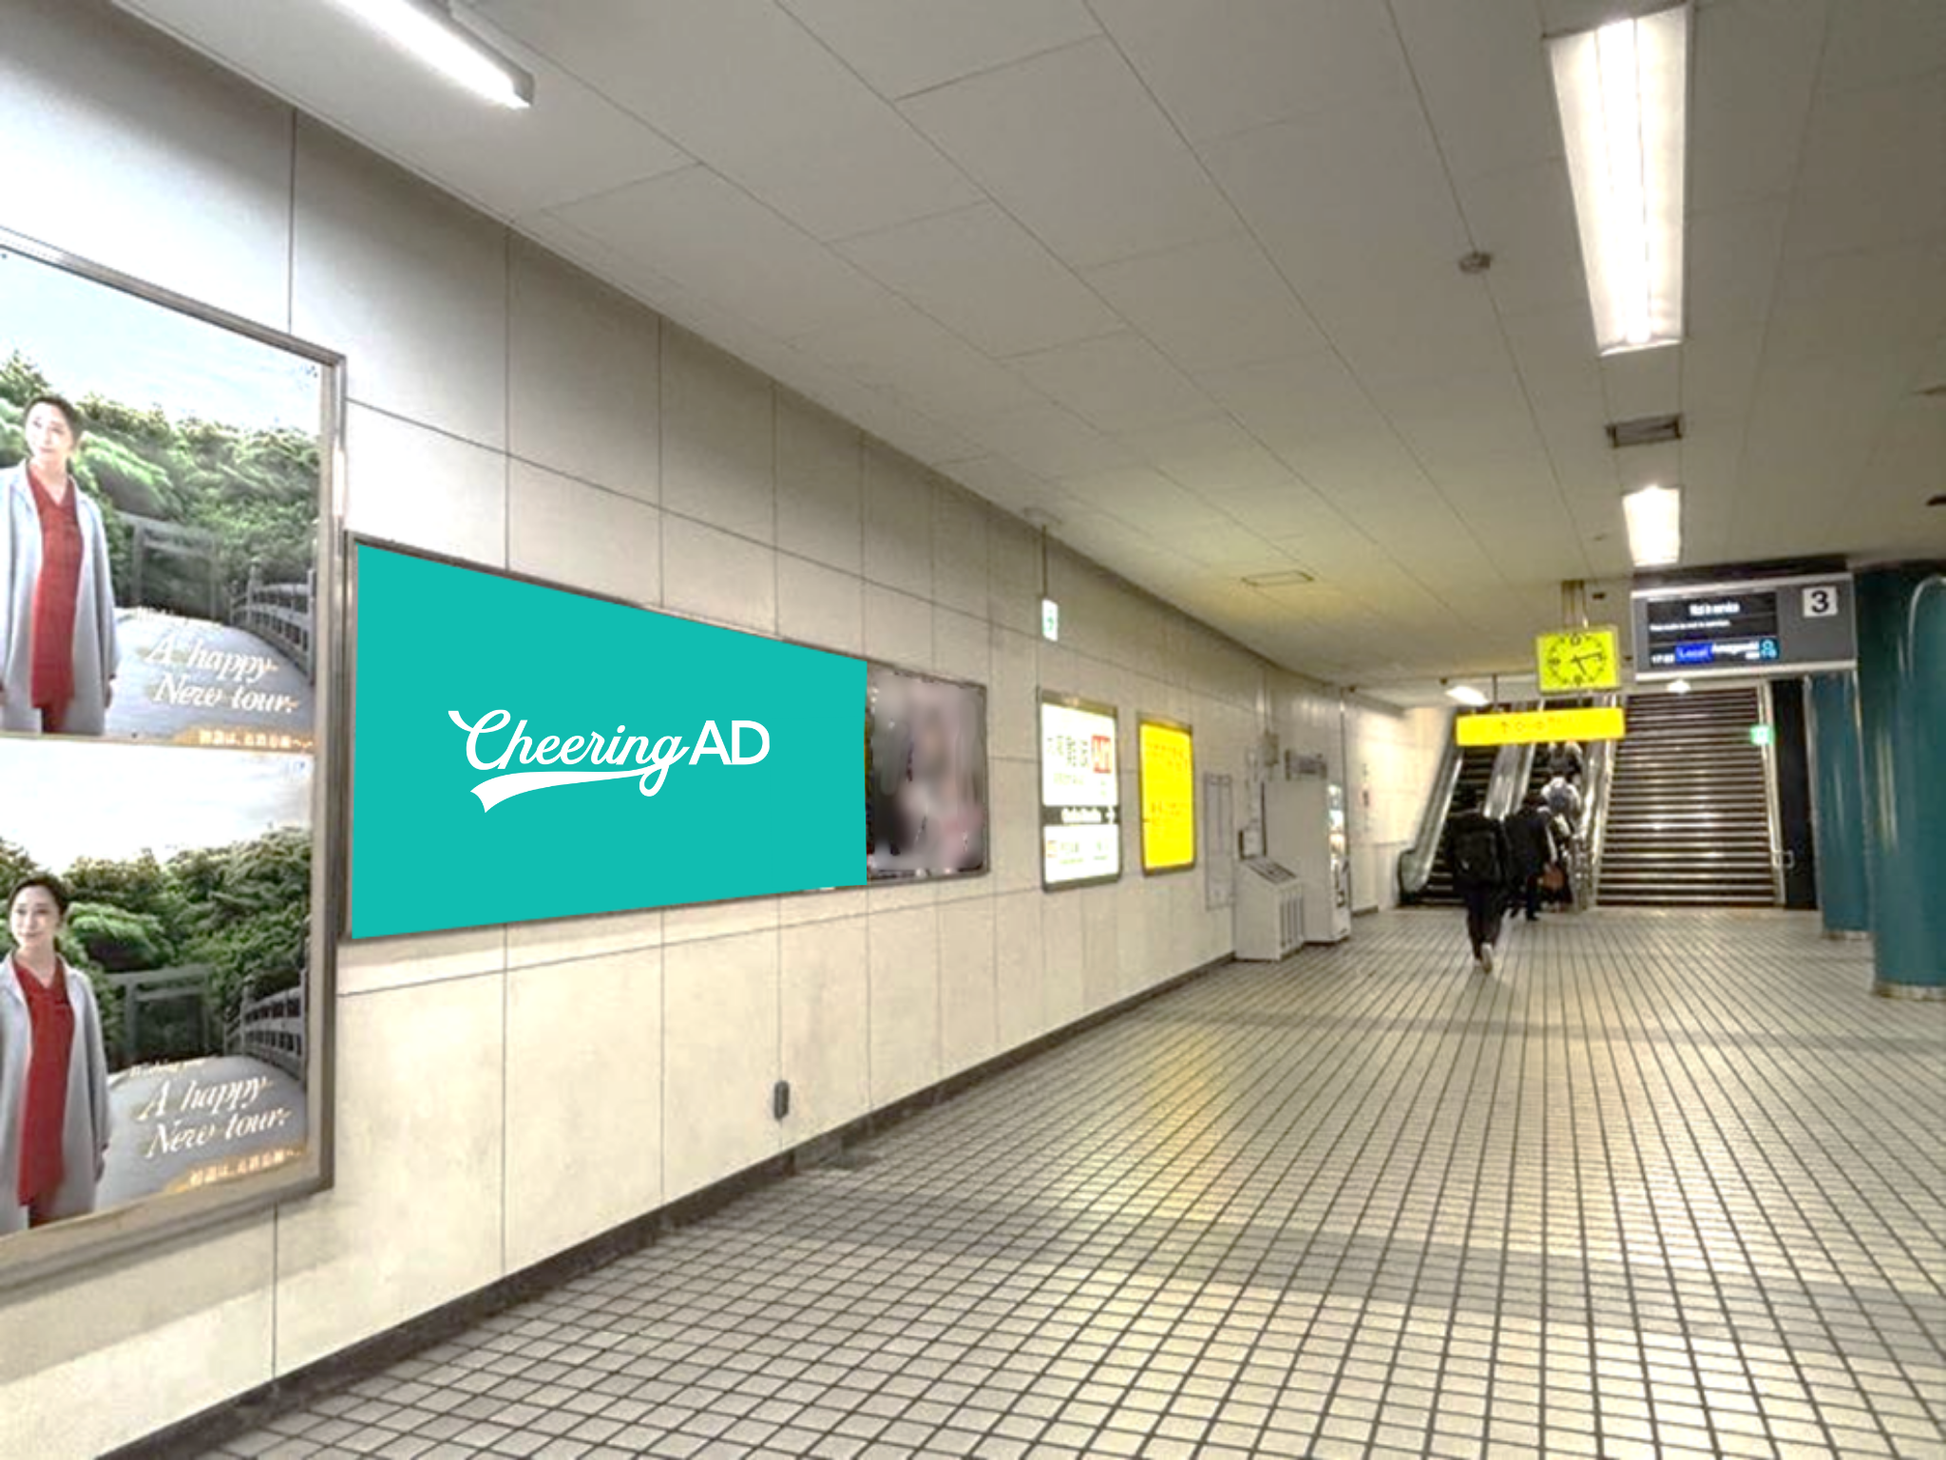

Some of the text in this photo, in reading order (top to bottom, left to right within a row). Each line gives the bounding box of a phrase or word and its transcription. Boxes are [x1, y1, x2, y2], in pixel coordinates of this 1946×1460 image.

[1810, 591, 1830, 613] 3
[143, 634, 274, 684] A happy
[153, 671, 223, 706] New
[448, 709, 771, 798] Cheering AD
[136, 1076, 271, 1121] A happy
[144, 1119, 215, 1159] New
